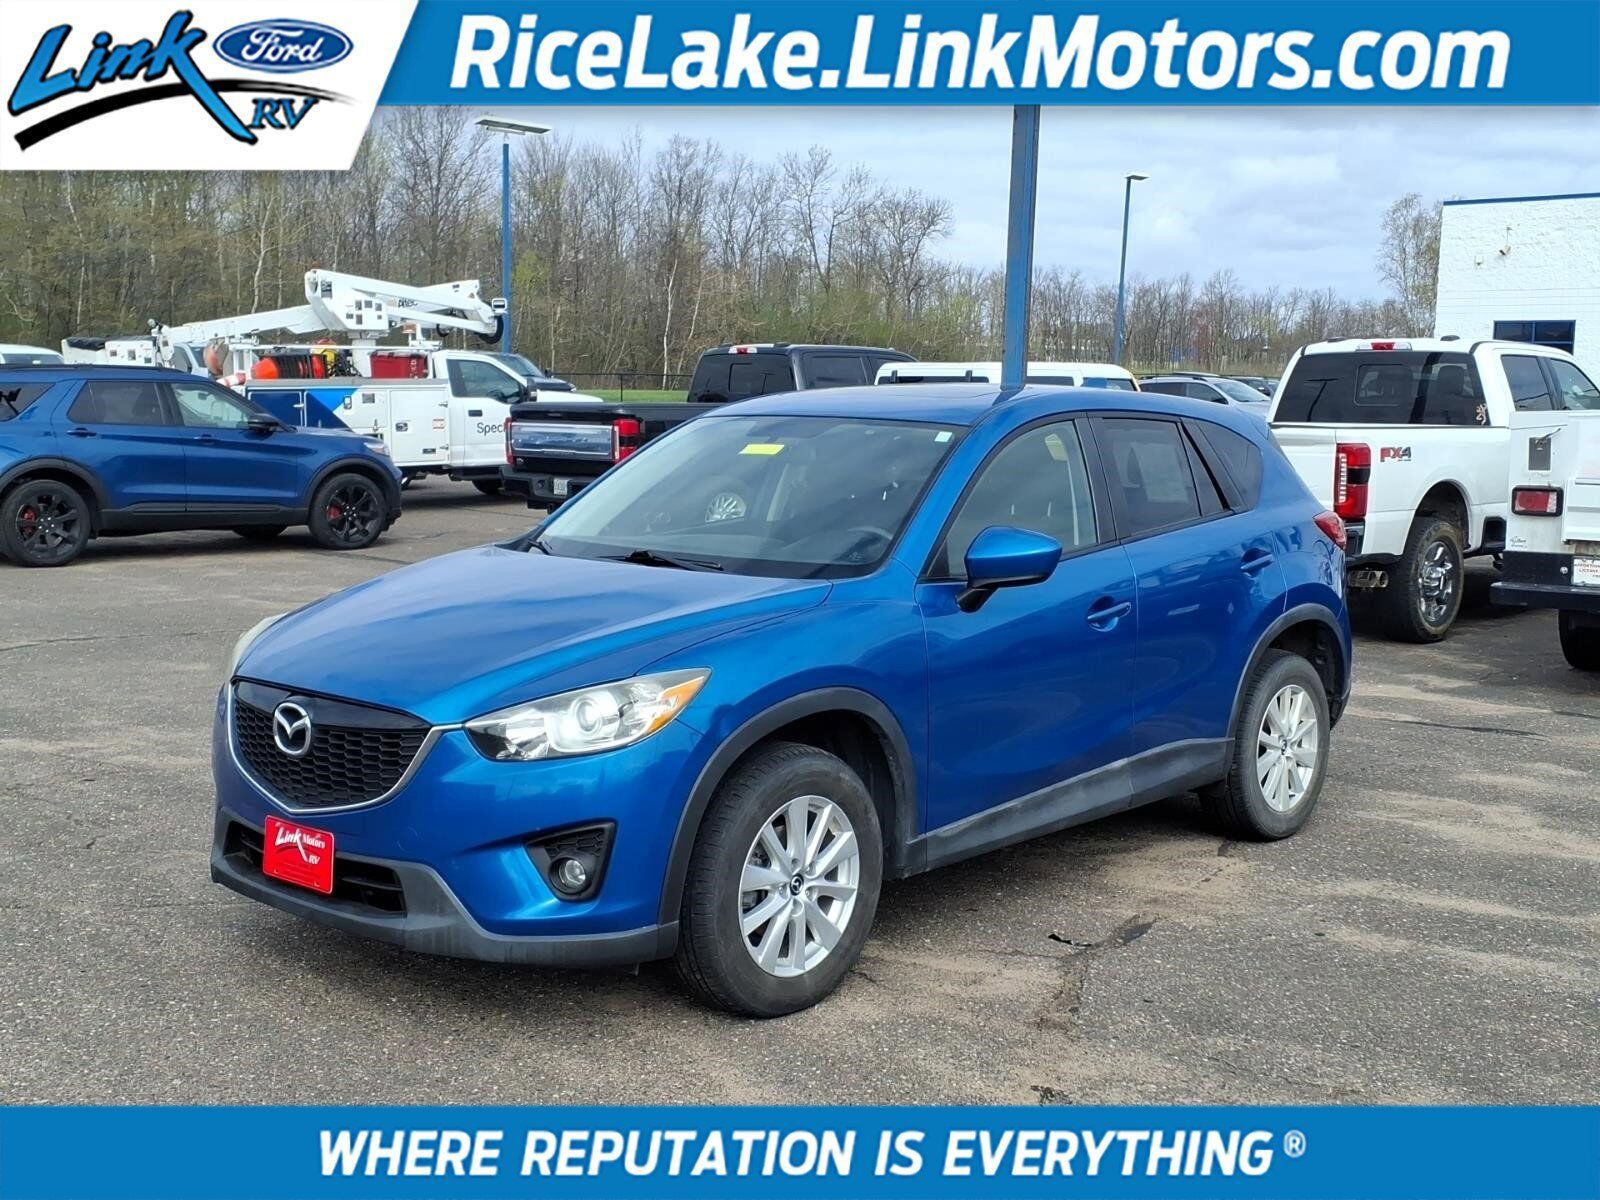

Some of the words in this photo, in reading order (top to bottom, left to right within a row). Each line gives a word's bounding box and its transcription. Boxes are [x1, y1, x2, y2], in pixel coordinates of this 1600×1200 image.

[1380, 446, 1411, 462] FX4
[275, 826, 309, 862] Link
[303, 833, 326, 848] Motors
[308, 854, 321, 865] RV
